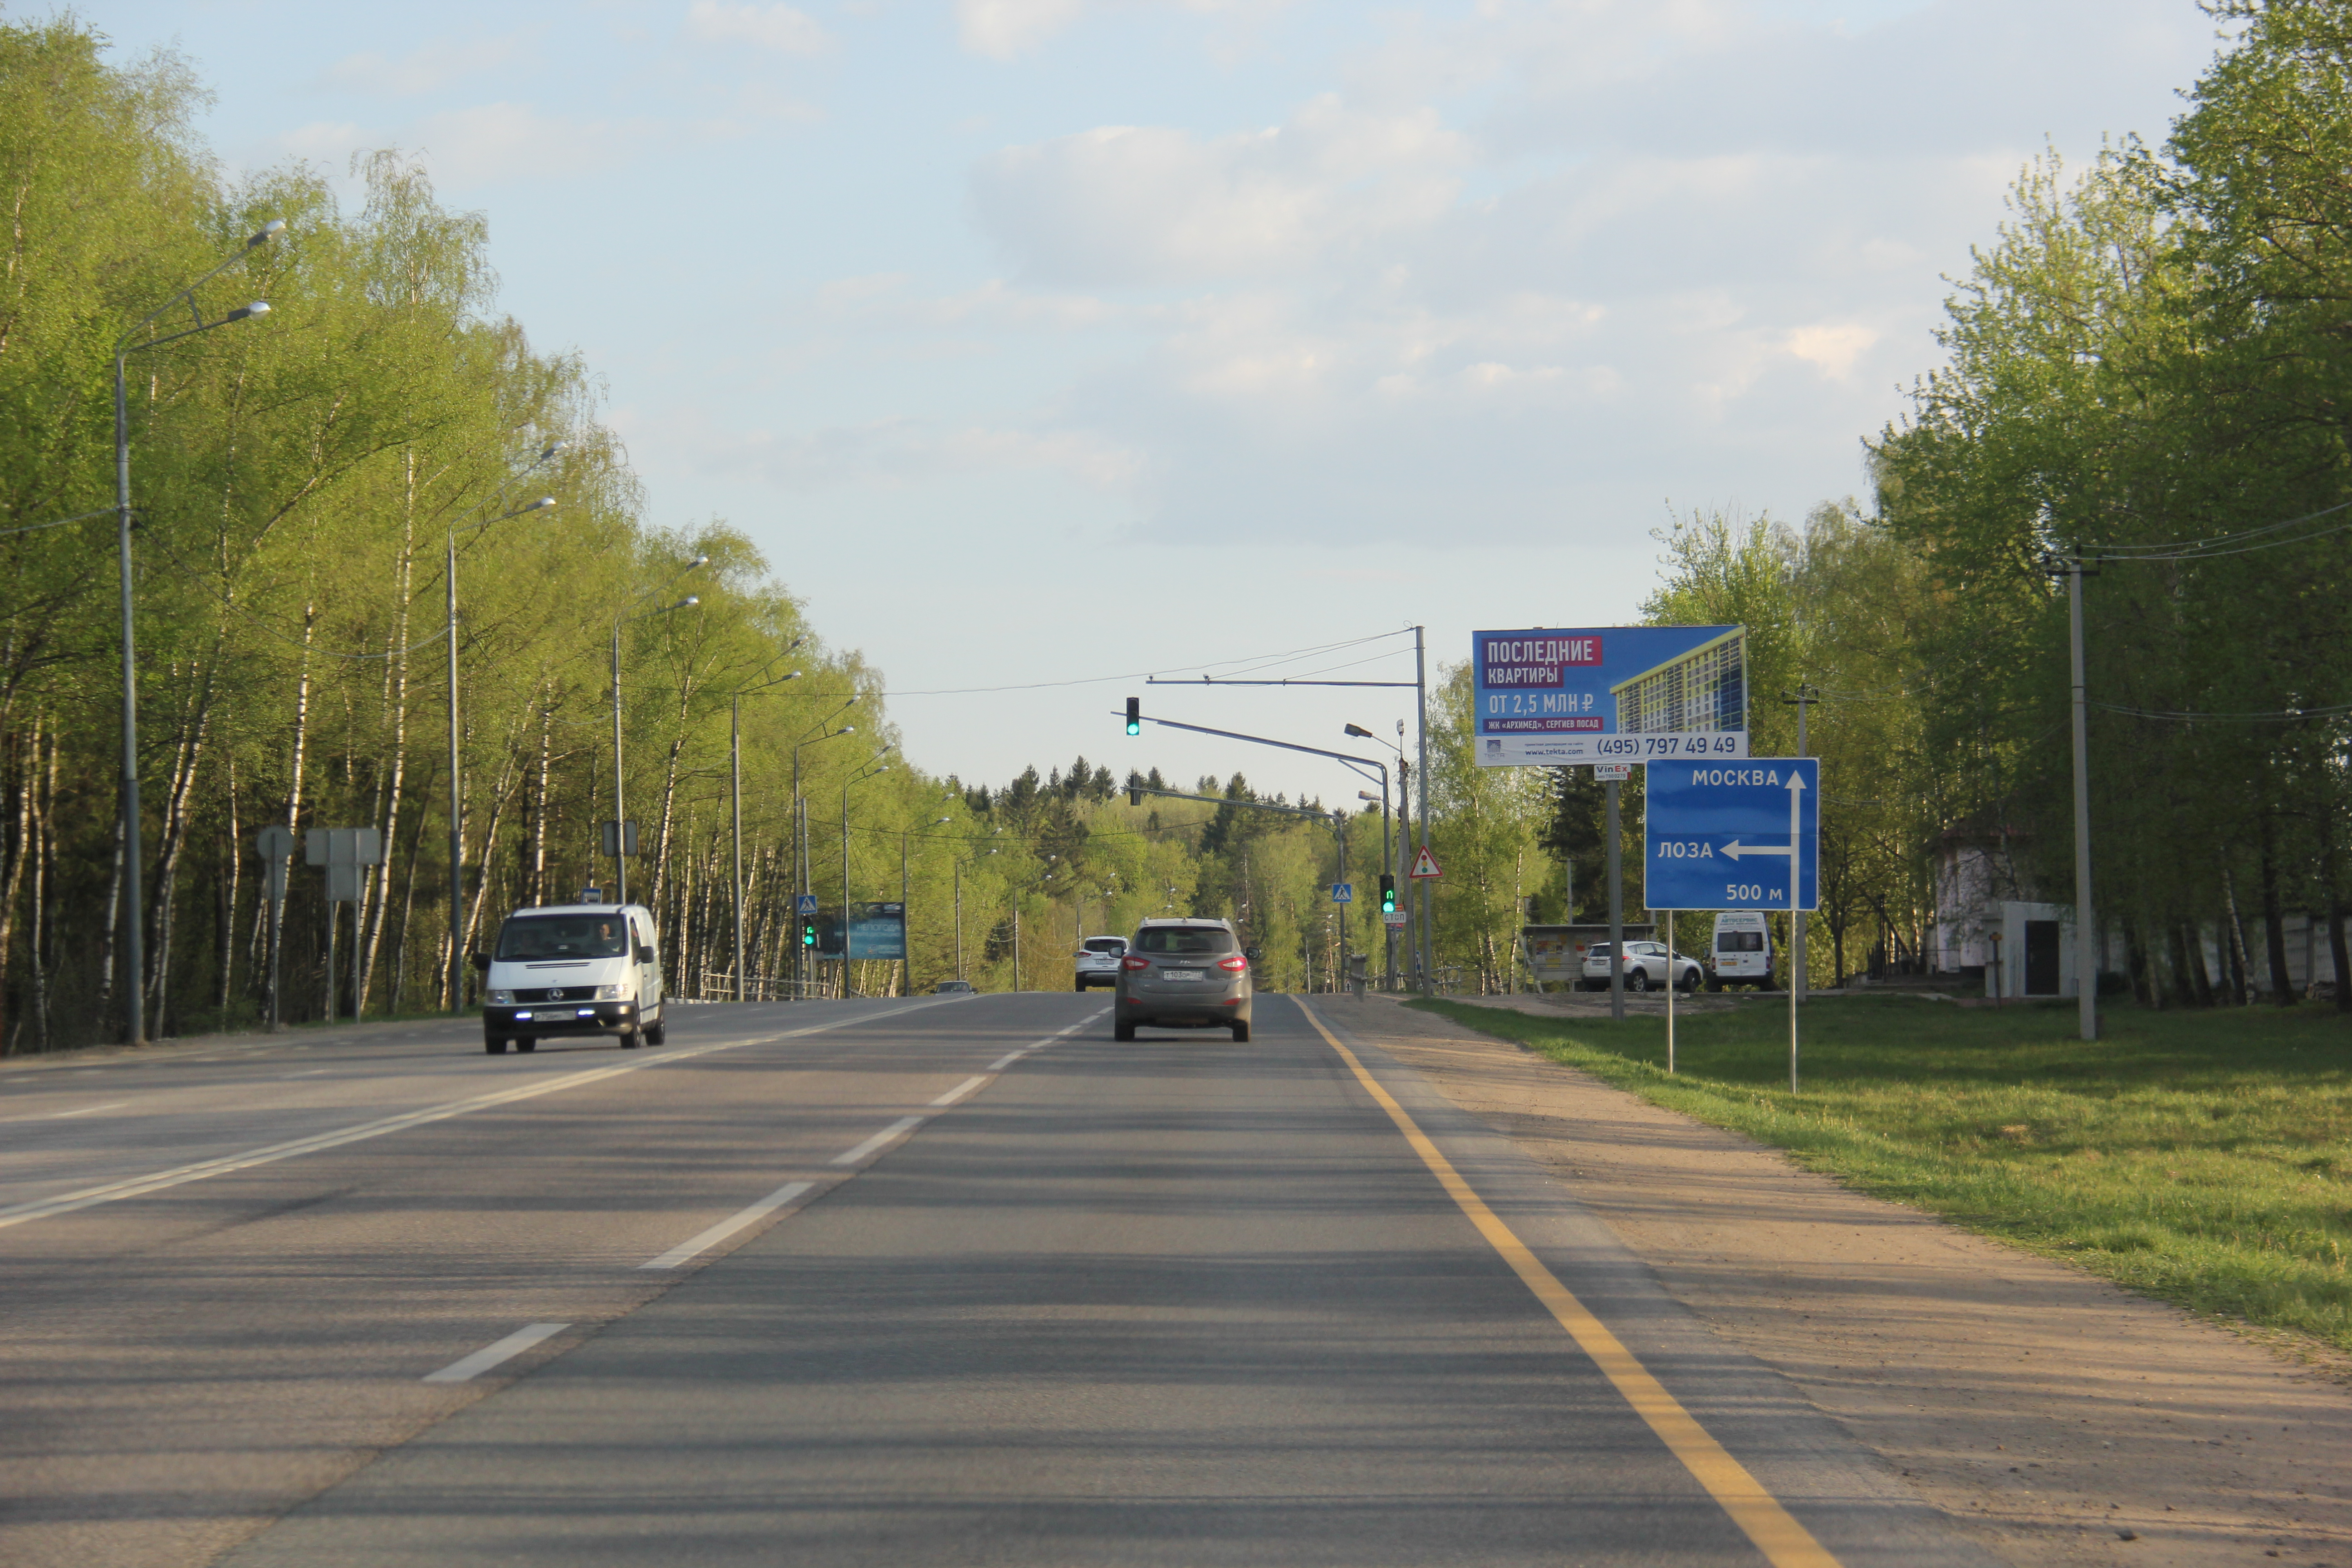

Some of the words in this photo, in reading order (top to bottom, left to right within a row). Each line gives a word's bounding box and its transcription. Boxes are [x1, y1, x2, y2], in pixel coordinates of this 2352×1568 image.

[1488, 640, 1593, 665] ПОСЛЕДНИЕ
[1488, 667, 1557, 684] КВАРТИРЫ
[1490, 695, 1507, 713] ОТ
[1513, 695, 1537, 716] 2,5
[1544, 694, 1578, 713] МЛН
[1502, 720, 1544, 730] «АРХИМЕД»,
[1546, 720, 1574, 729] СЕРГИЕВ
[1577, 719, 1599, 729] ПОСАД
[1597, 739, 1639, 755] (495)
[1646, 738, 1678, 755] 797
[1685, 738, 1707, 754] 49
[1713, 737, 1735, 753] 49
[1692, 770, 1779, 786] МОСКВА
[1658, 842, 1713, 858] ЛОЗА
[1726, 884, 1761, 900] 500
